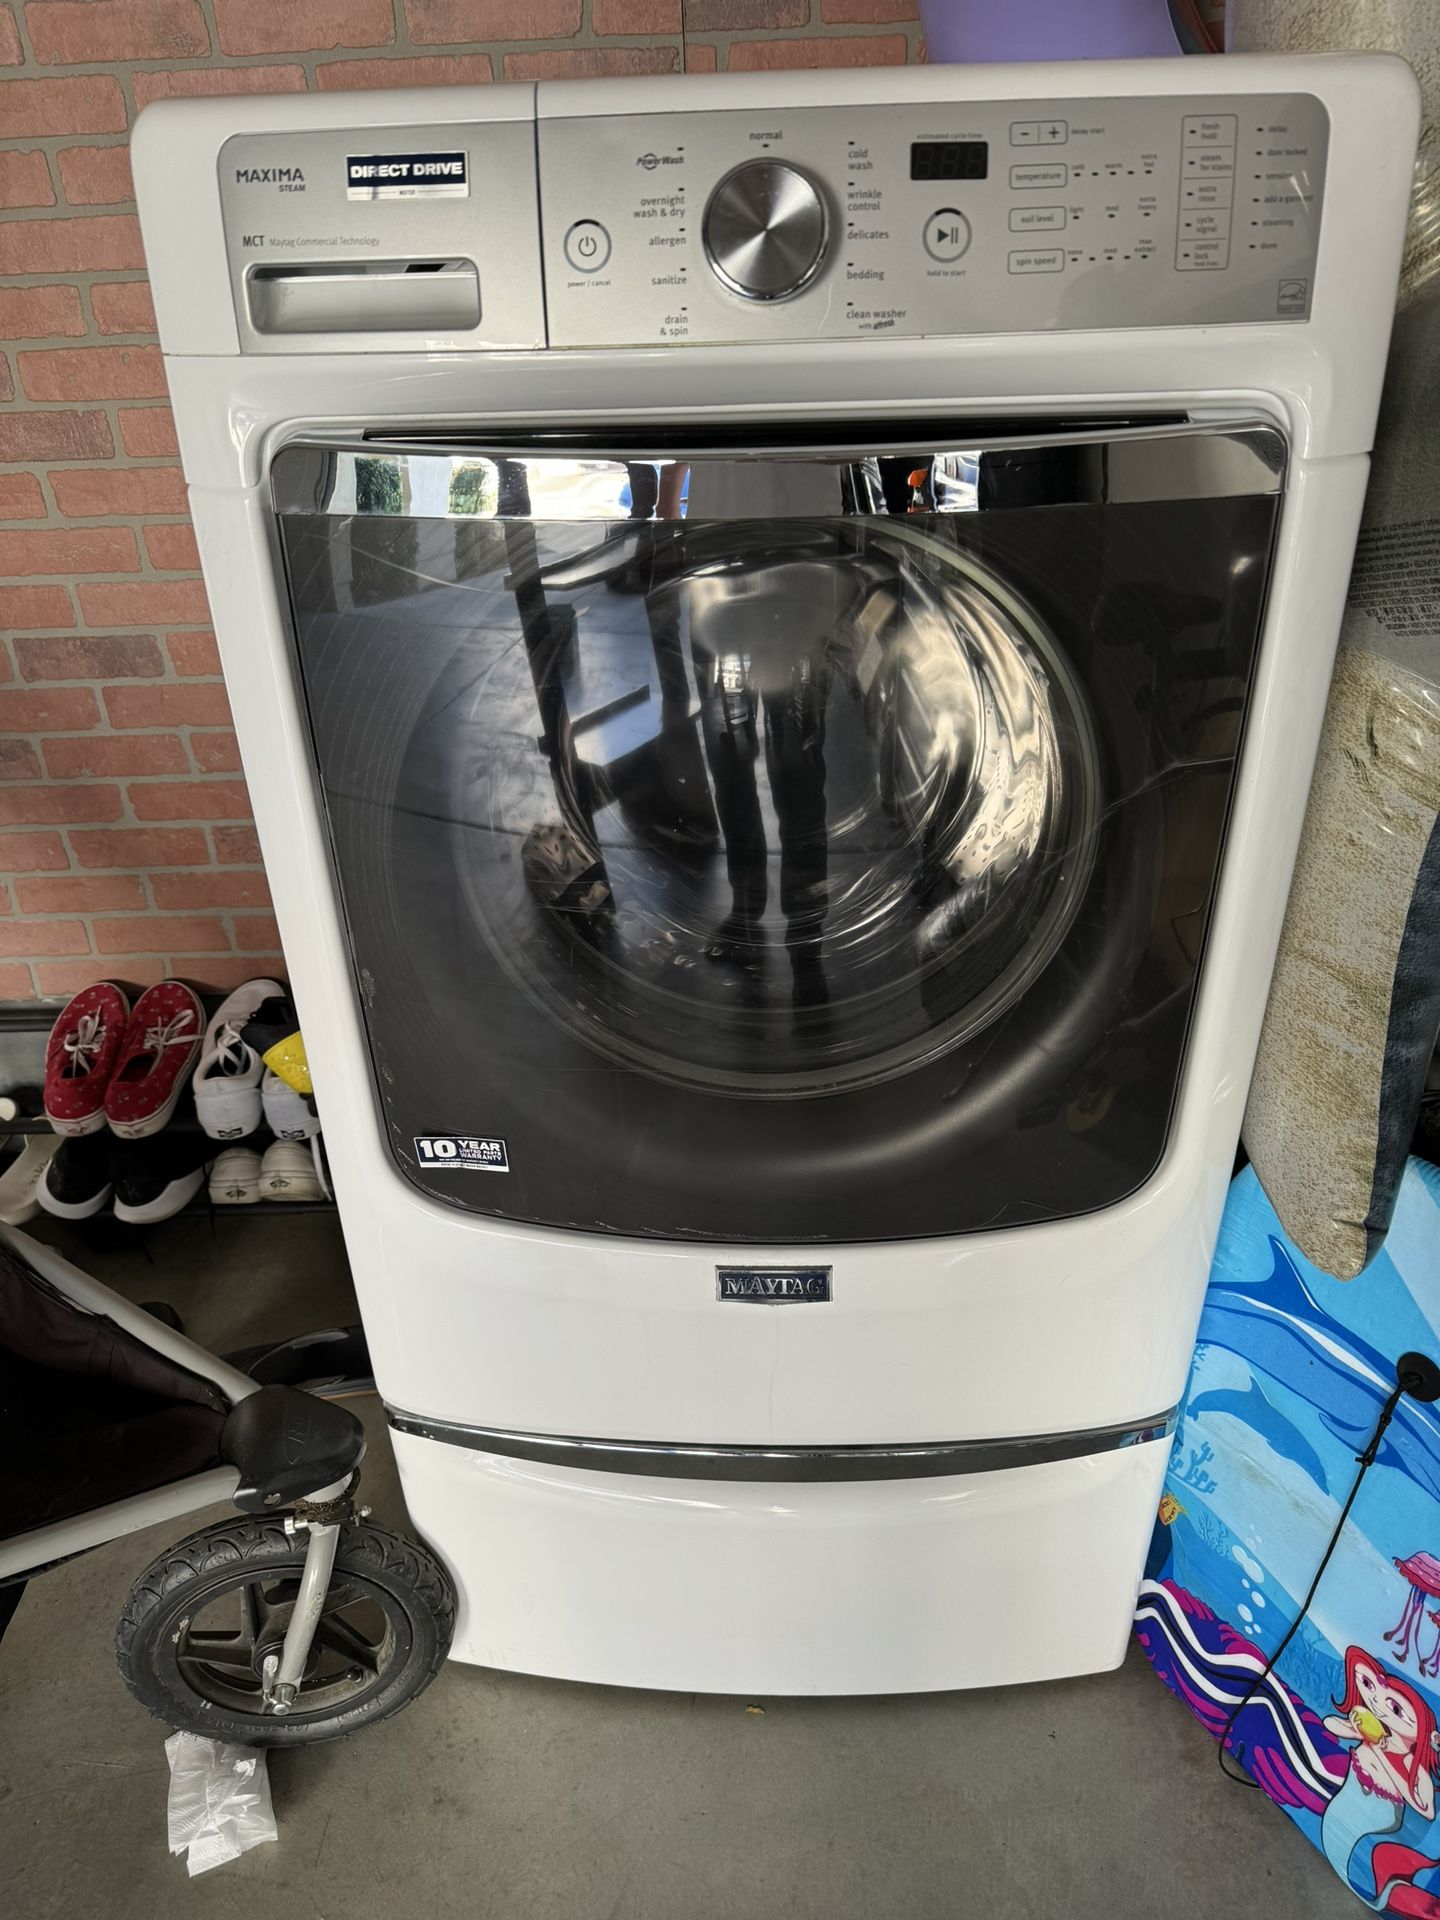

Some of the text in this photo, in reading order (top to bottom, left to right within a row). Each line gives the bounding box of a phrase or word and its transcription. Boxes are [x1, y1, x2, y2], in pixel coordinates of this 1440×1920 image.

[749, 130, 783, 140] normal
[848, 148, 868, 159] cold
[350, 162, 463, 178] DIRECT DRIVE
[848, 161, 873, 170] wash
[236, 168, 305, 183] MAXIMA
[1015, 172, 1061, 182] temperature
[279, 184, 306, 193] STEAM
[848, 189, 882, 199] wrinkle
[641, 195, 685, 207] overnight
[848, 201, 881, 211] control
[633, 207, 685, 218] wash & dry
[1021, 214, 1054, 223] soil level
[847, 229, 889, 240] delicates
[243, 235, 380, 249] MCT Maytag Commercial Technology
[649, 236, 687, 247] allergen
[1016, 256, 1056, 266] spin speed
[651, 275, 687, 285] sanitize
[847, 269, 884, 281] bedding
[567, 280, 586, 288] power
[591, 279, 611, 287] cancel
[664, 314, 688, 324] drain
[846, 308, 906, 319] clean washer
[660, 326, 688, 337] & spin
[420, 1140, 500, 1158] 10 YEAR
[460, 1152, 502, 1161] WARRANTY
[725, 1277, 824, 1296] MAYTAG
